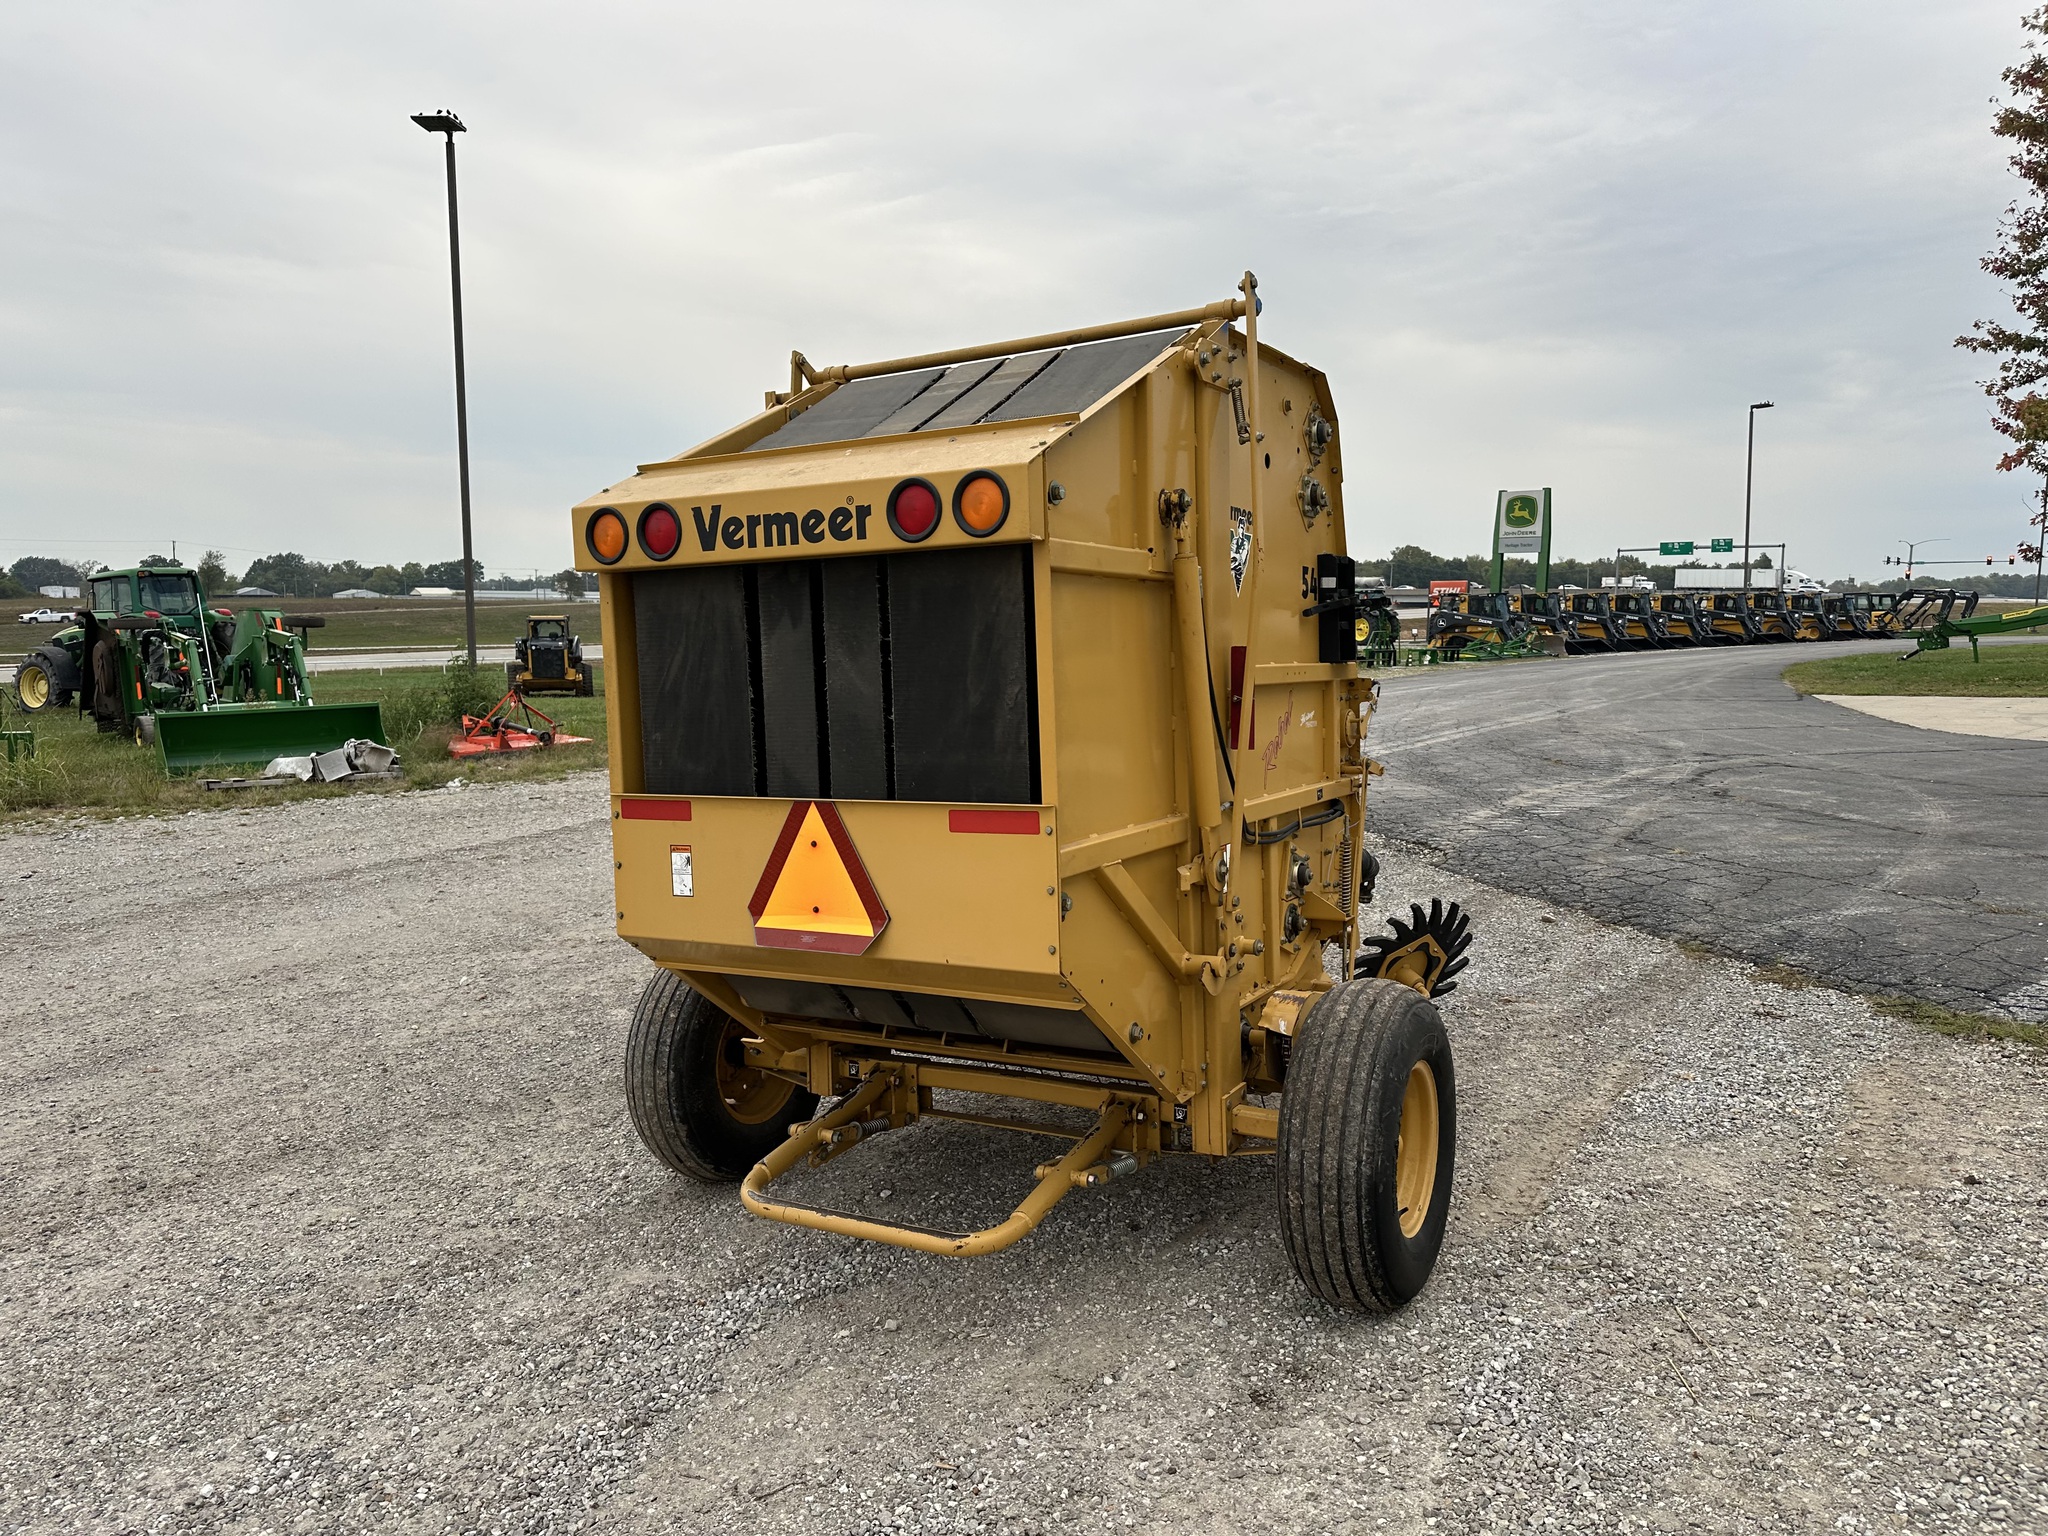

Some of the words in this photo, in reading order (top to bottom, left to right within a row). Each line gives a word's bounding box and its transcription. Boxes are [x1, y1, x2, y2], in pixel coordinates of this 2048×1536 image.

[1230, 505, 1253, 526] rmee
[691, 503, 872, 551] Vermeer
[1432, 587, 1461, 595] STIHL
